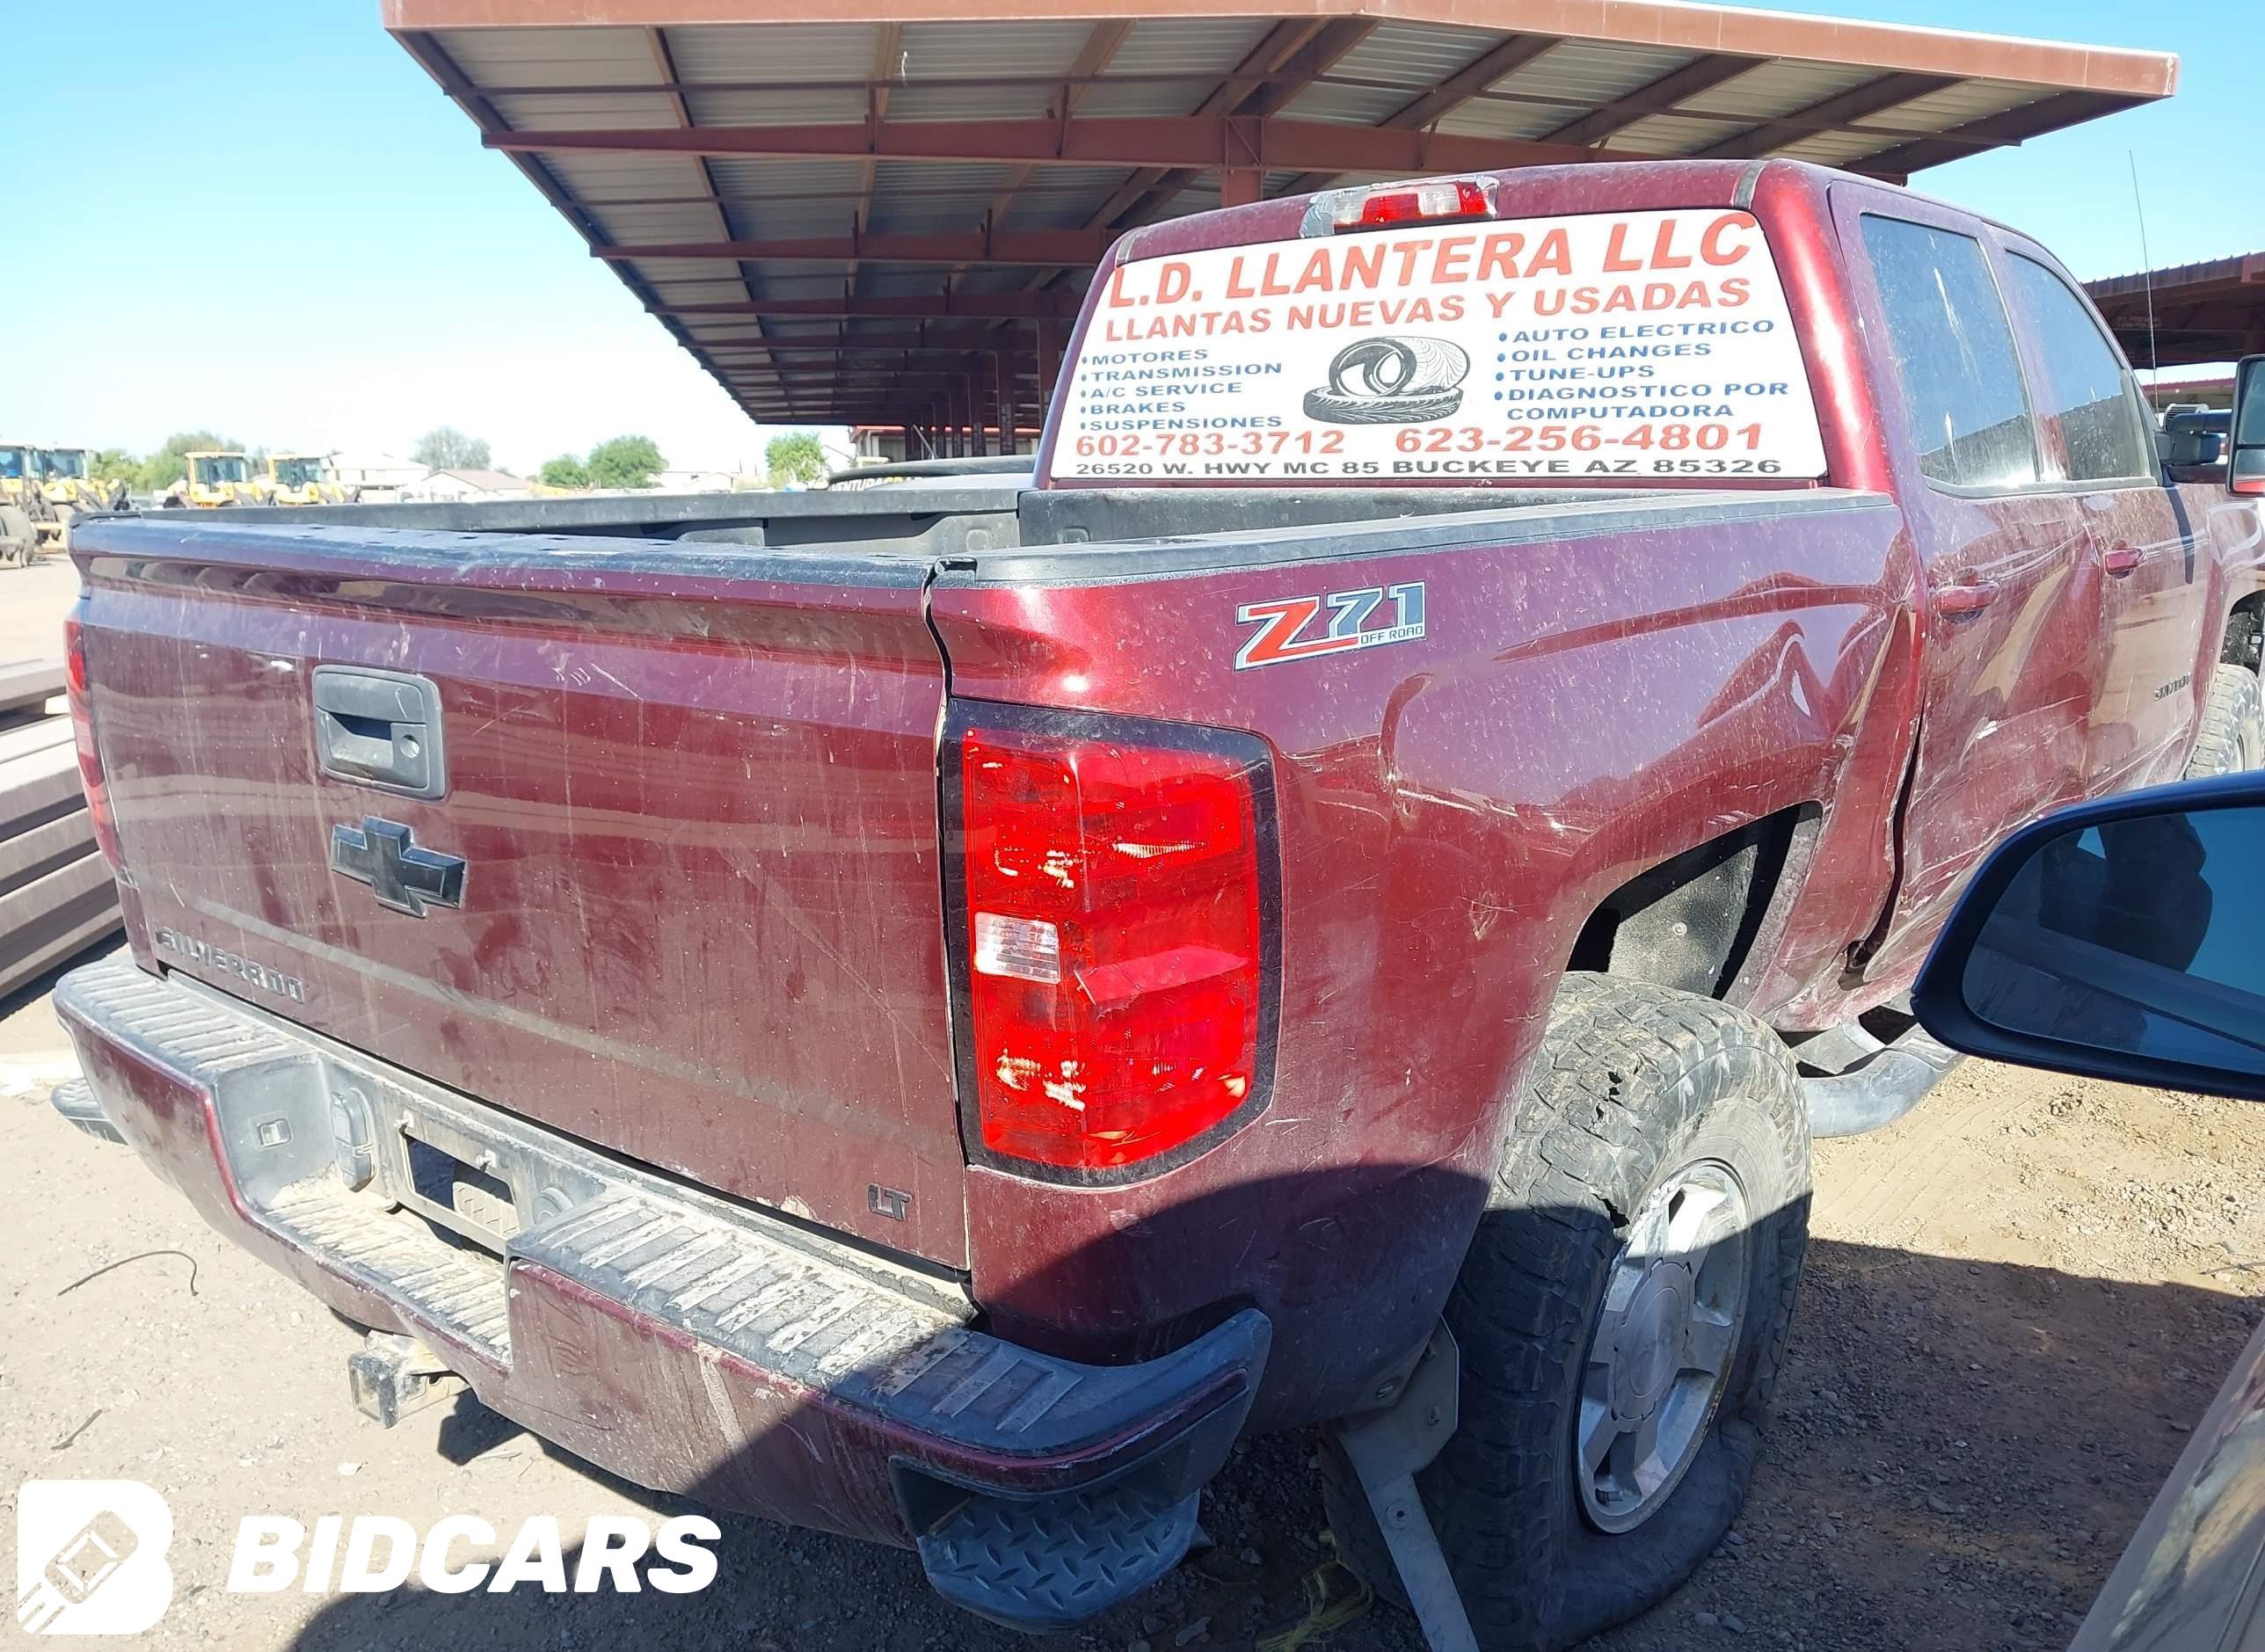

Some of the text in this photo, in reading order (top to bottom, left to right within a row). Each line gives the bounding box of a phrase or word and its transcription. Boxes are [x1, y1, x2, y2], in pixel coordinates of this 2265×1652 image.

[1108, 211, 1757, 308] L.D. LLANTERA LLC
[1106, 278, 1750, 341] LLANTAS NUEVAS Y USADAS
[1512, 320, 1773, 342] AUTO ELECTRICO
[1092, 349, 1207, 365] MOTORES
[1512, 343, 1711, 361] OIL CHANGES
[1091, 363, 1281, 382] TRANSMISSION
[1510, 366, 1655, 381] TUNE-UPS
[1090, 382, 1242, 398] A/C SERVICE
[1509, 382, 1788, 401] DIAGNOSTICO POR
[1090, 402, 1185, 414] BRAKES
[1507, 404, 1734, 420] COMPUTADORA
[1090, 417, 1282, 431] SUSPENSIONES
[1076, 423, 1761, 456] 602-783-3712 623-256-4801
[1076, 460, 1781, 474] 26520 W. HWY MC 85 BUCKEYE AZ 85326
[1232, 579, 1426, 673] Z71
[1360, 624, 1423, 644] OFF ROAD
[154, 926, 305, 1004] SILVERADO
[867, 1182, 913, 1222] LT
